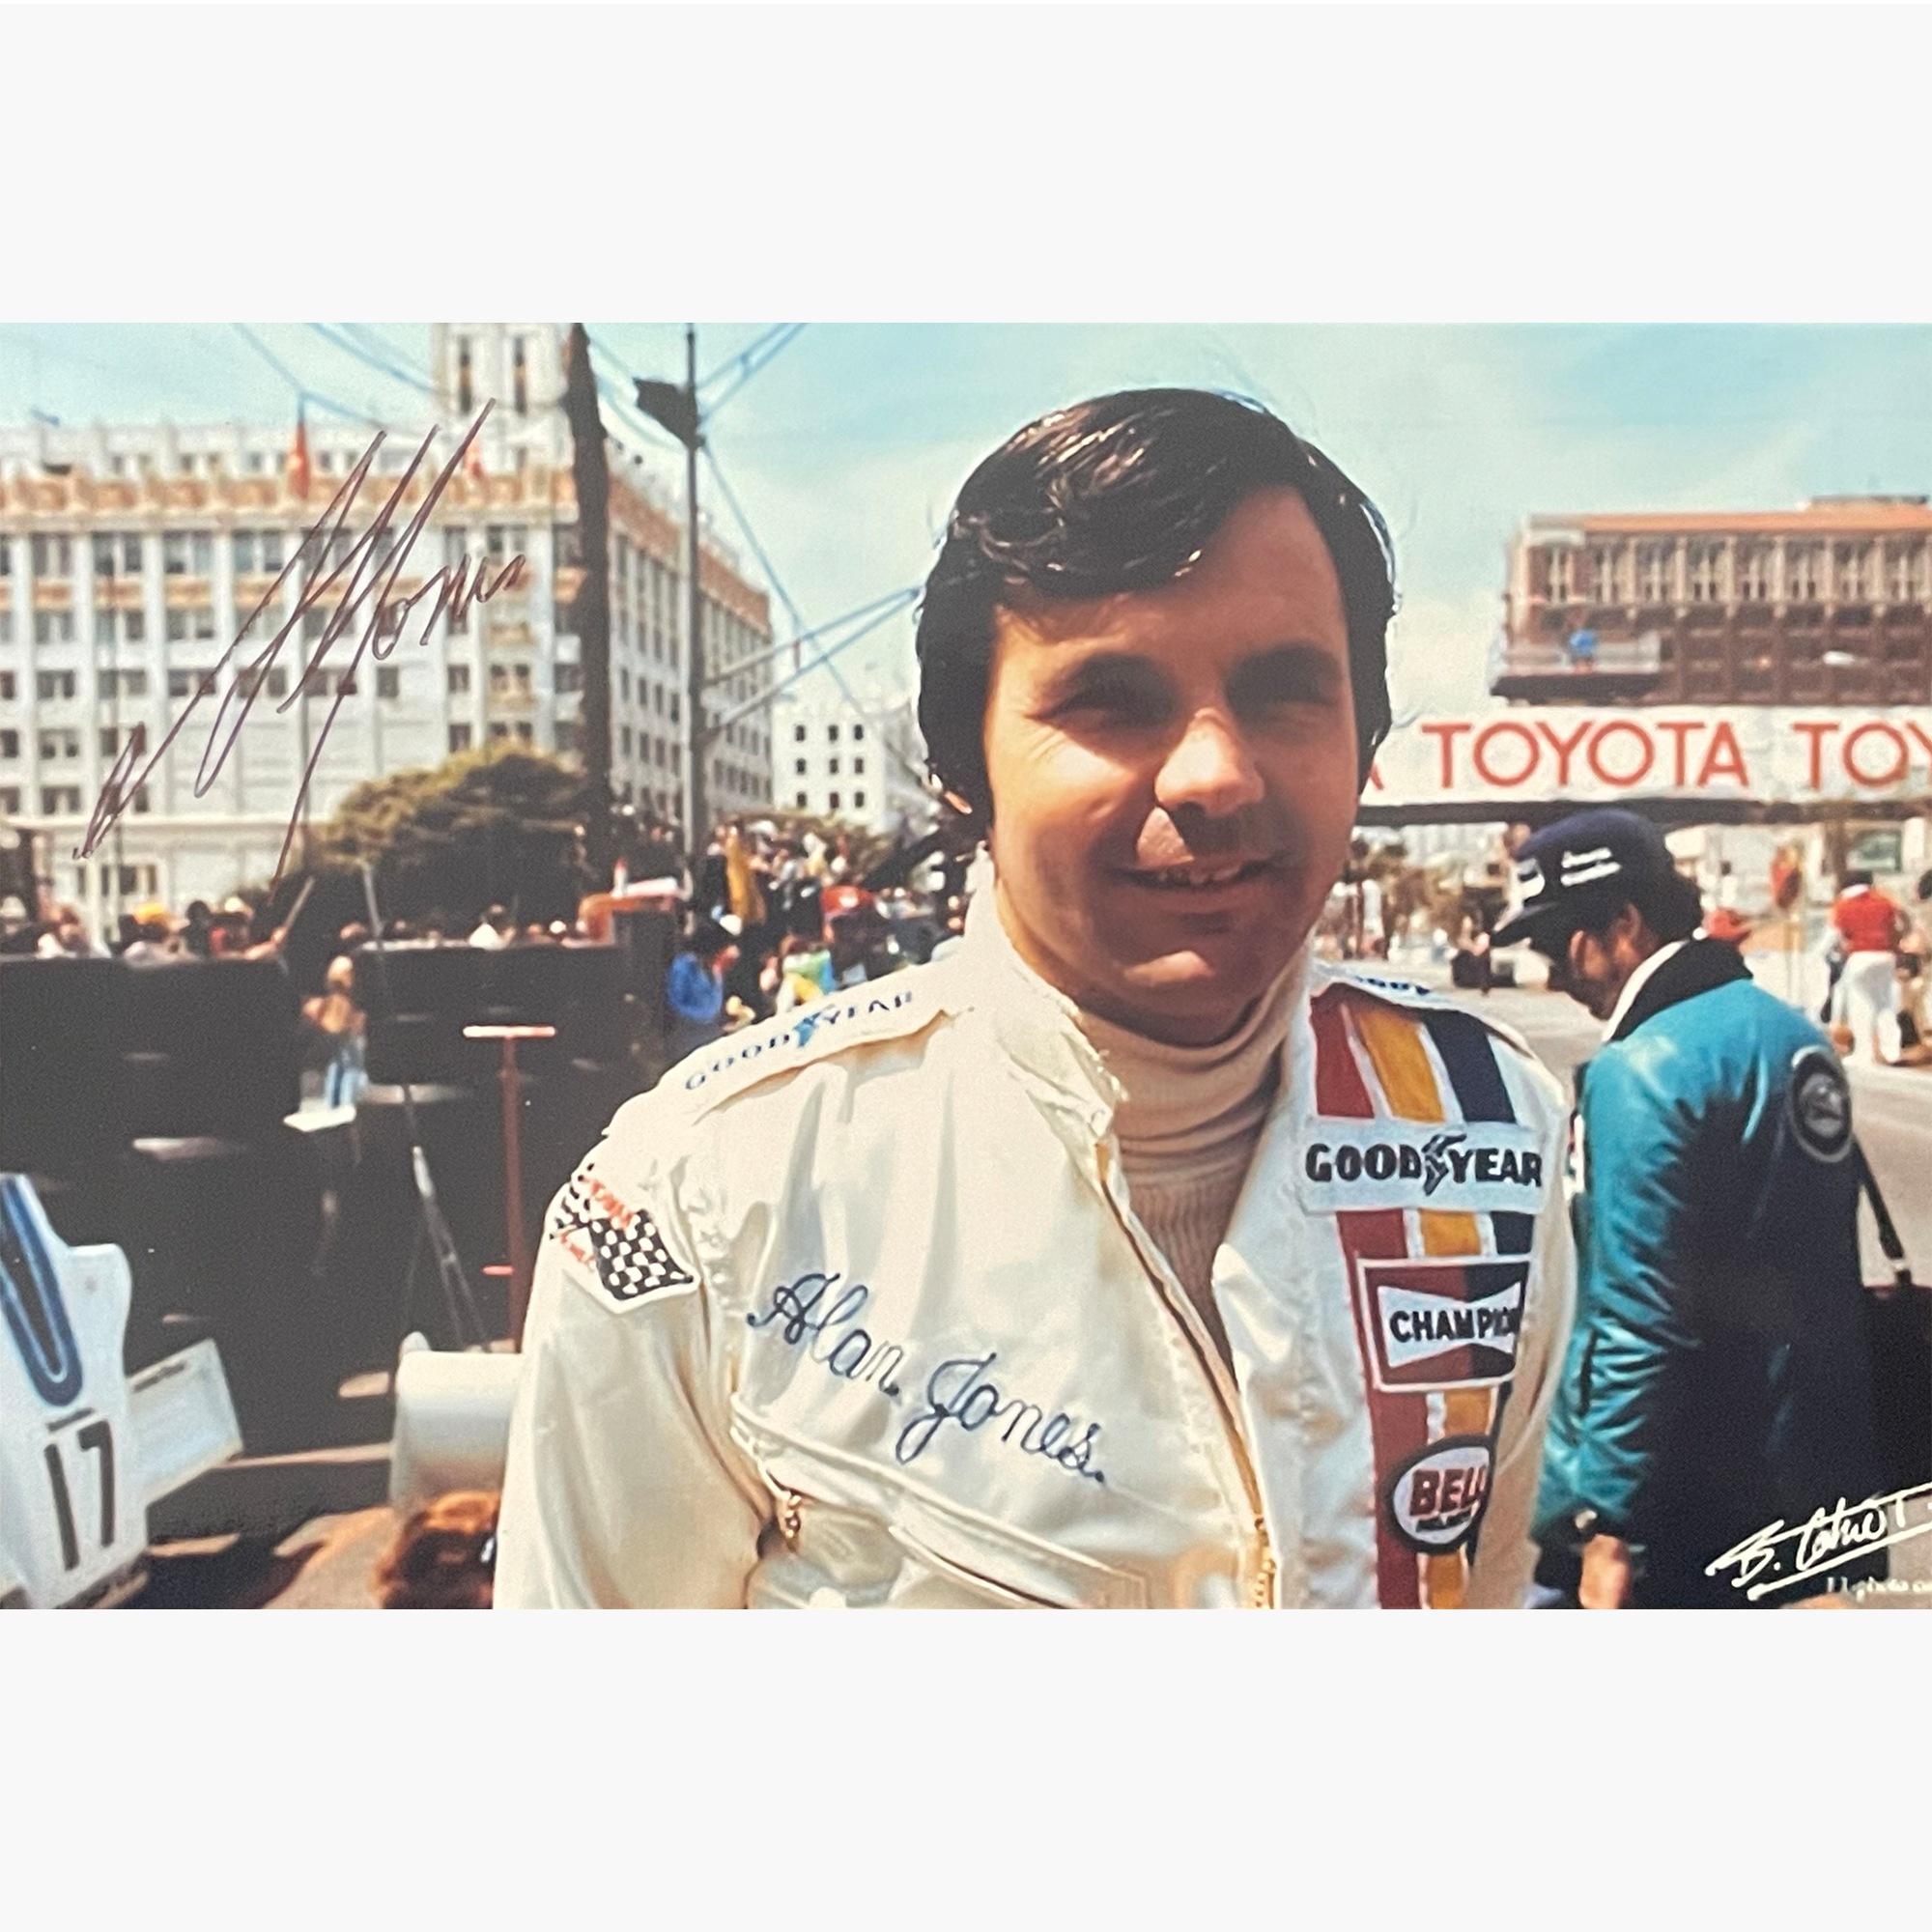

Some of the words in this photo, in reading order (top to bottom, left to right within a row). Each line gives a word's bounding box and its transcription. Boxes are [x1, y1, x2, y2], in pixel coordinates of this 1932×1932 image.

[1421, 721, 1748, 788] TOYOTA
[1305, 1135, 1544, 1192] GOODYEAR
[44, 1419, 115, 1571] 17
